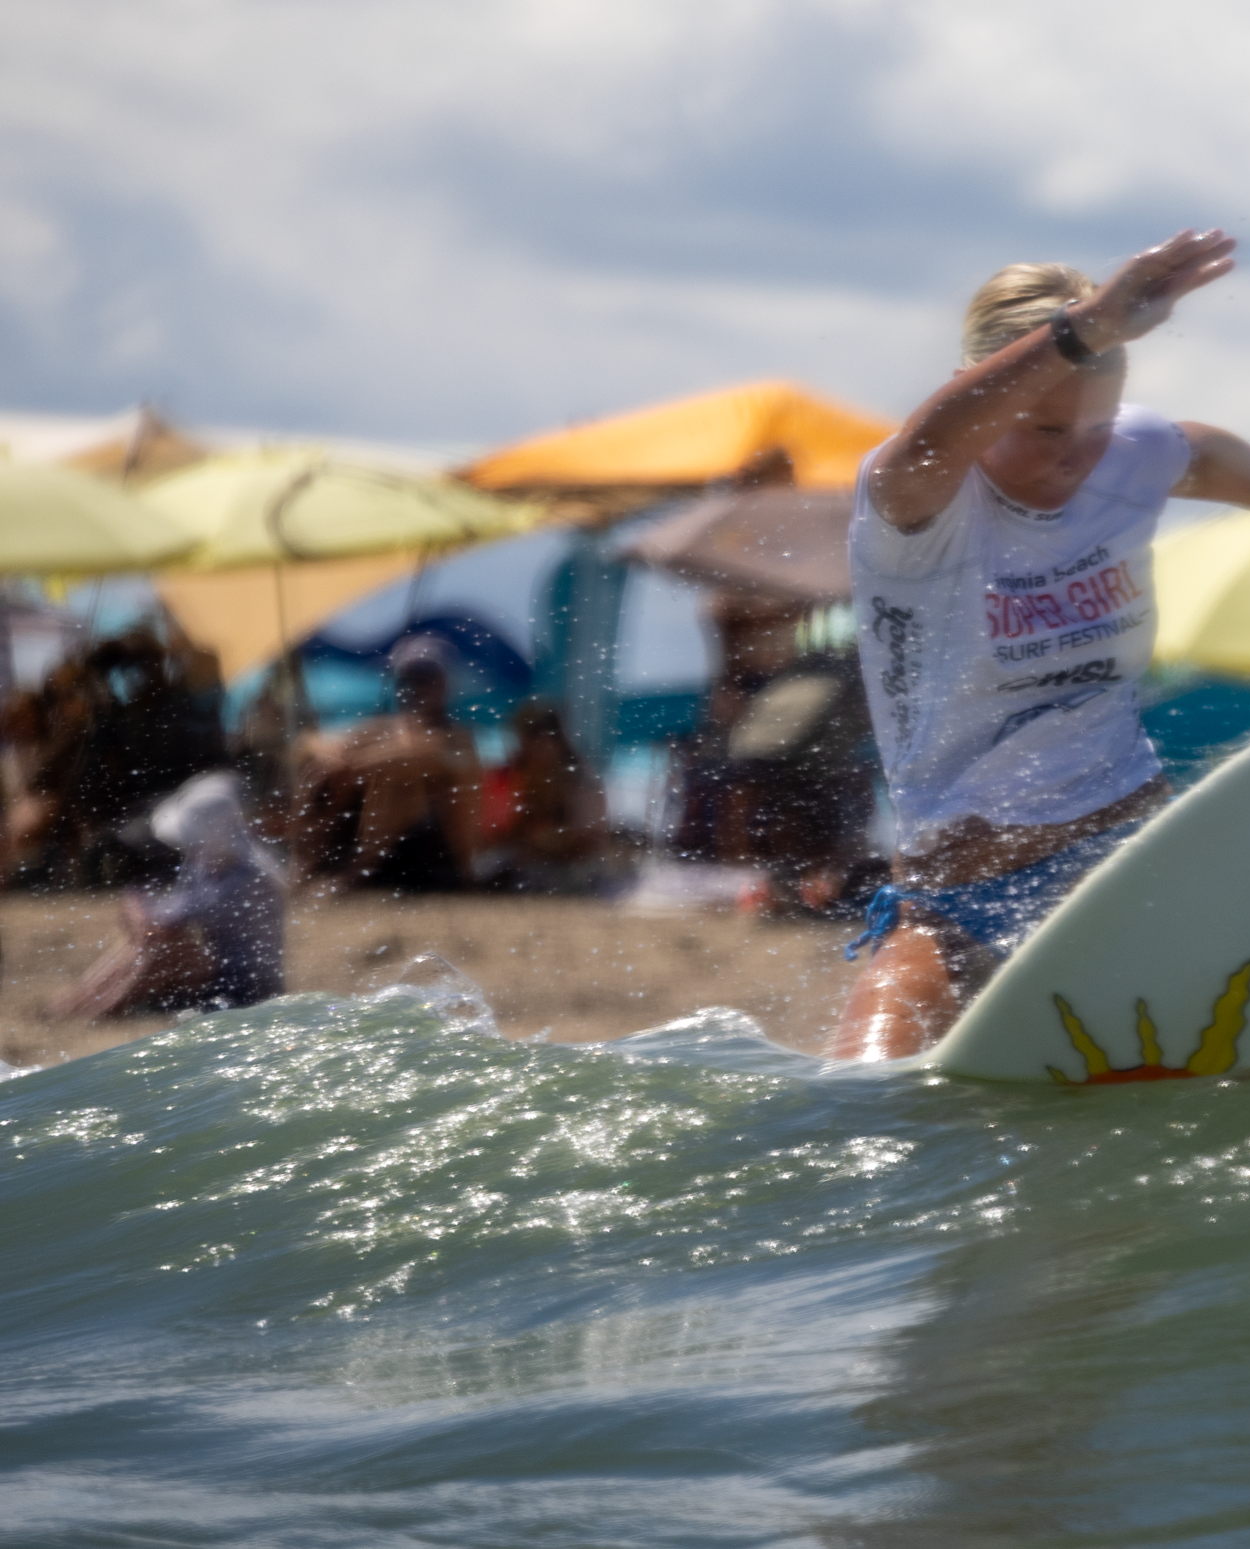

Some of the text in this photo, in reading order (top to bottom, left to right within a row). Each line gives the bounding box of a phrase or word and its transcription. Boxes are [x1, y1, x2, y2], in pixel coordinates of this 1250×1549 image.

[1052, 546, 1109, 583] beach
[985, 560, 1143, 640] SUPER GIRL
